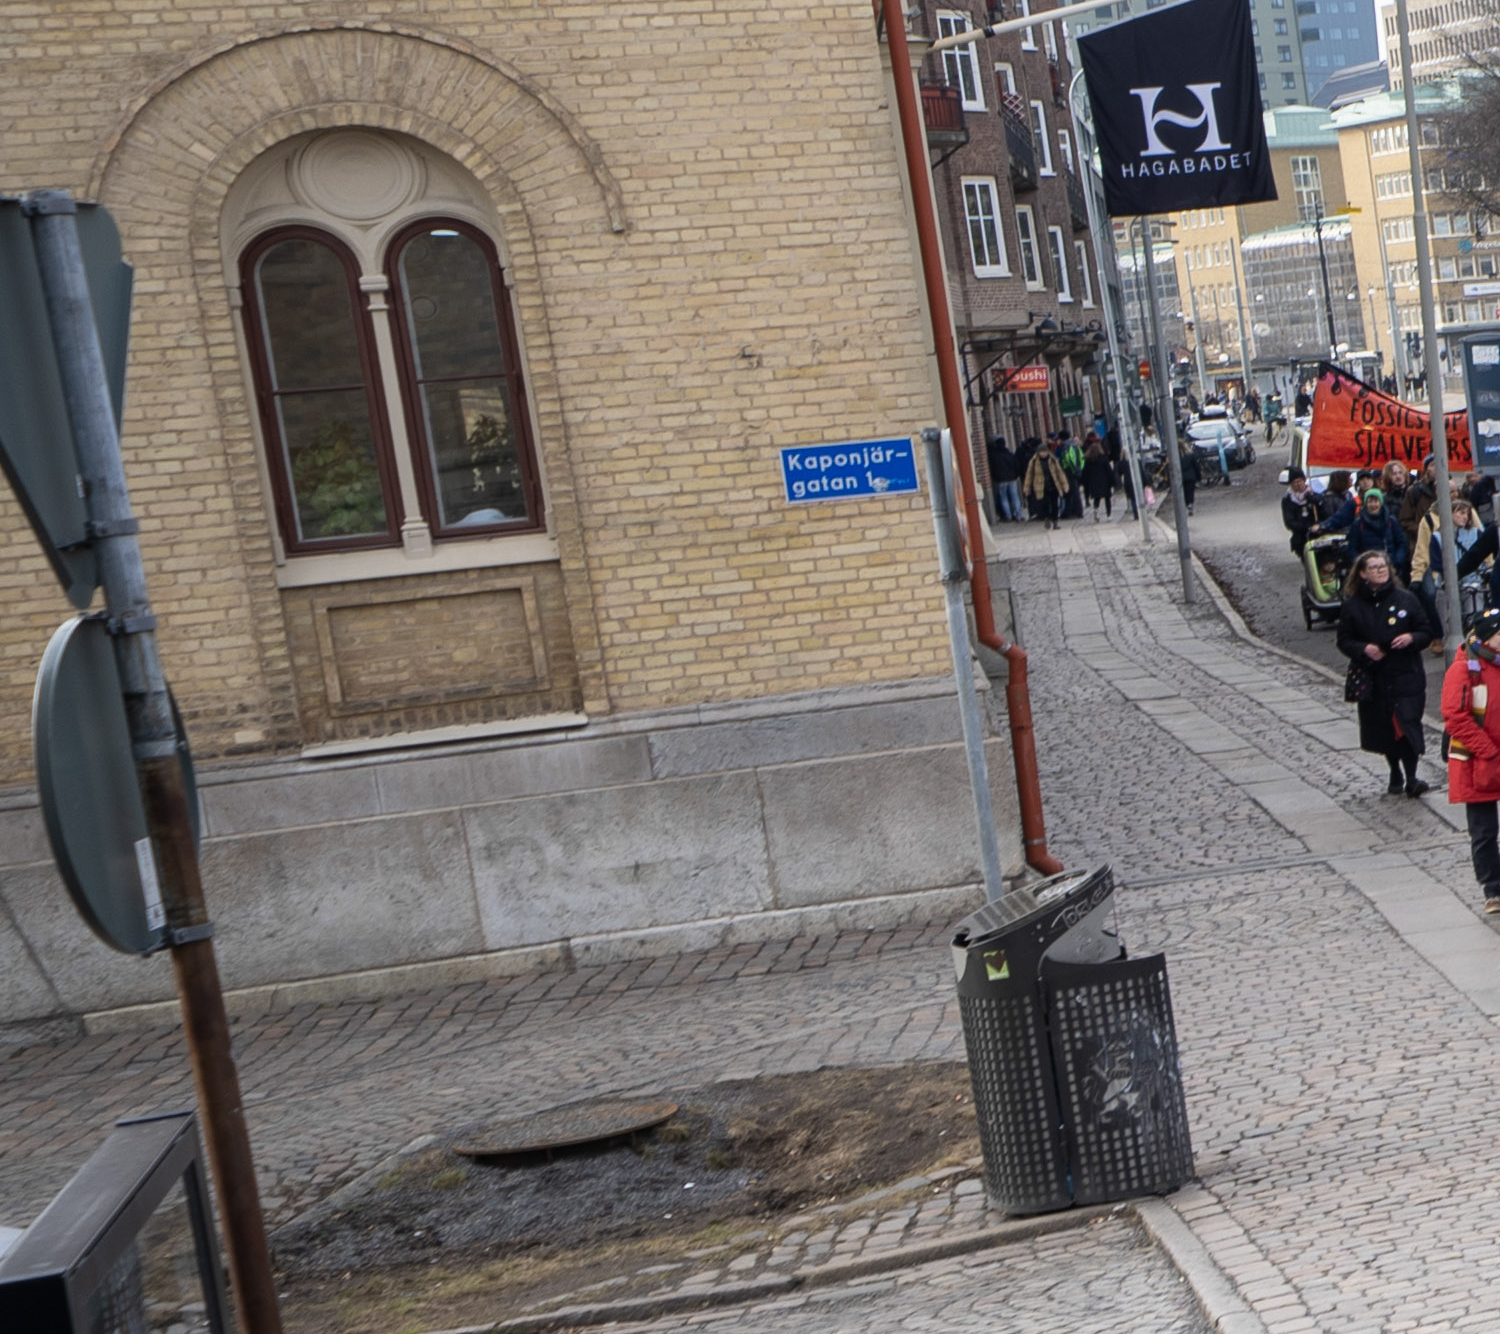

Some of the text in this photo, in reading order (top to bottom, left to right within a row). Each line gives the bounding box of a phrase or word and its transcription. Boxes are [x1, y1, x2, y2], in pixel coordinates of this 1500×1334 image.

[1121, 151, 1252, 179] HAGABADET
[787, 446, 908, 472] Kaponjär-
[792, 475, 858, 499] gatan
